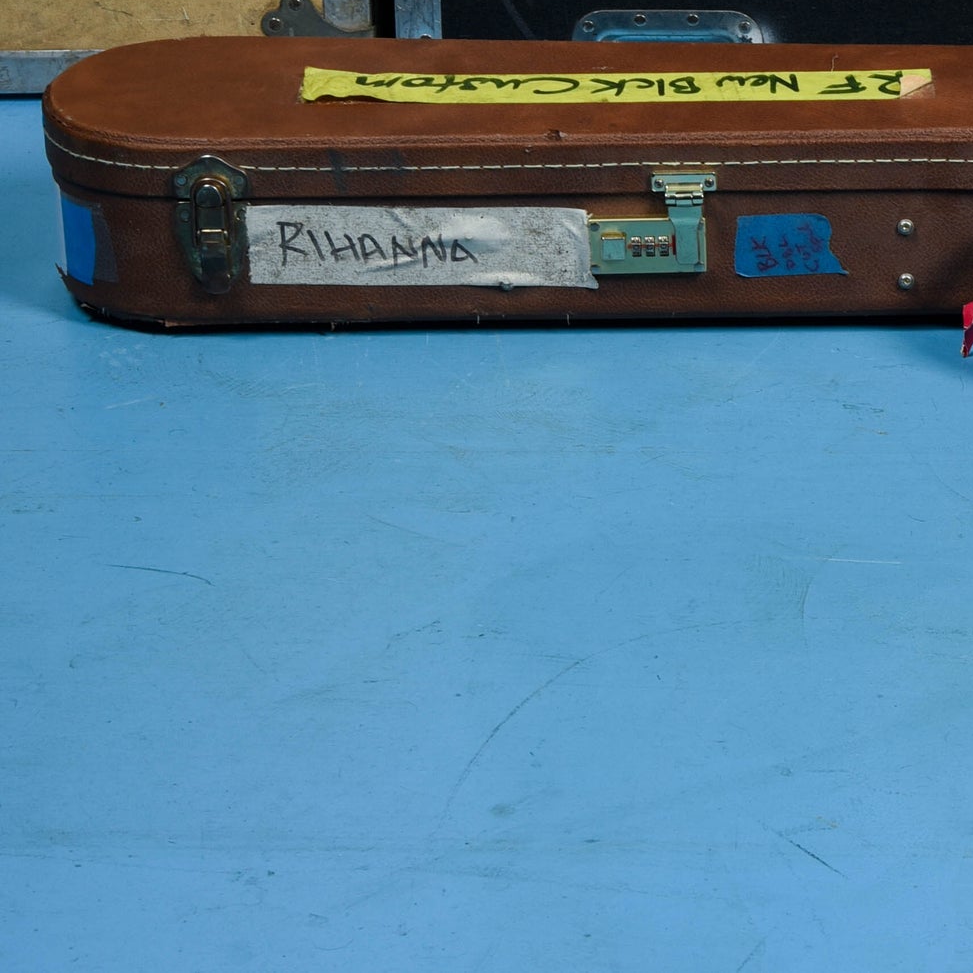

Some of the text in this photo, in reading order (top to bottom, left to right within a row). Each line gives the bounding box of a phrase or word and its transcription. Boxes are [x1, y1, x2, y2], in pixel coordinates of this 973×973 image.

[355, 75, 580, 94] Custom
[716, 73, 800, 94] New
[276, 221, 478, 268] RIHANNA
